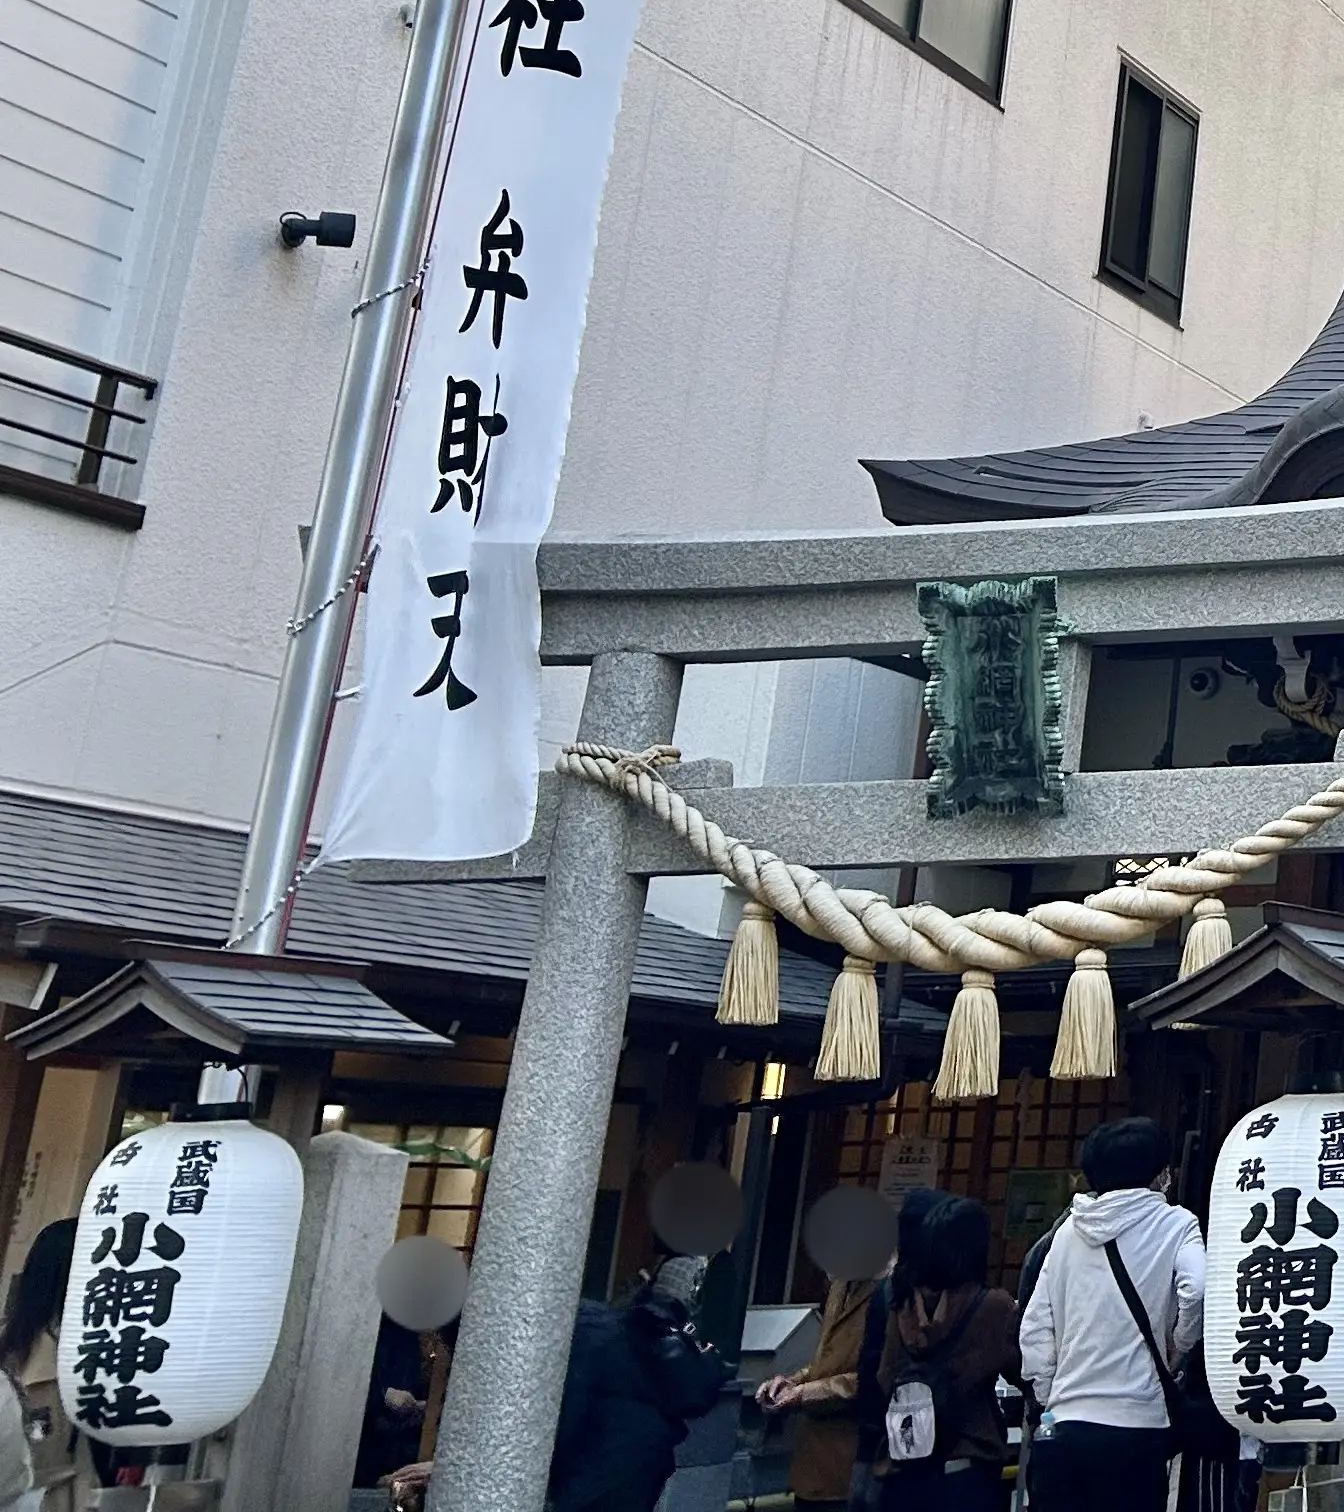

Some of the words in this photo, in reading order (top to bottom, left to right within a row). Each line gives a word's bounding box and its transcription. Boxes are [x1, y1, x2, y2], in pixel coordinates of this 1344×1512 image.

[412, 189, 529, 711] 弁財天
[166, 1140, 222, 1216] 武蔵国
[73, 1211, 186, 1429] 小網神社
[1232, 1187, 1340, 1425] 小網神社
